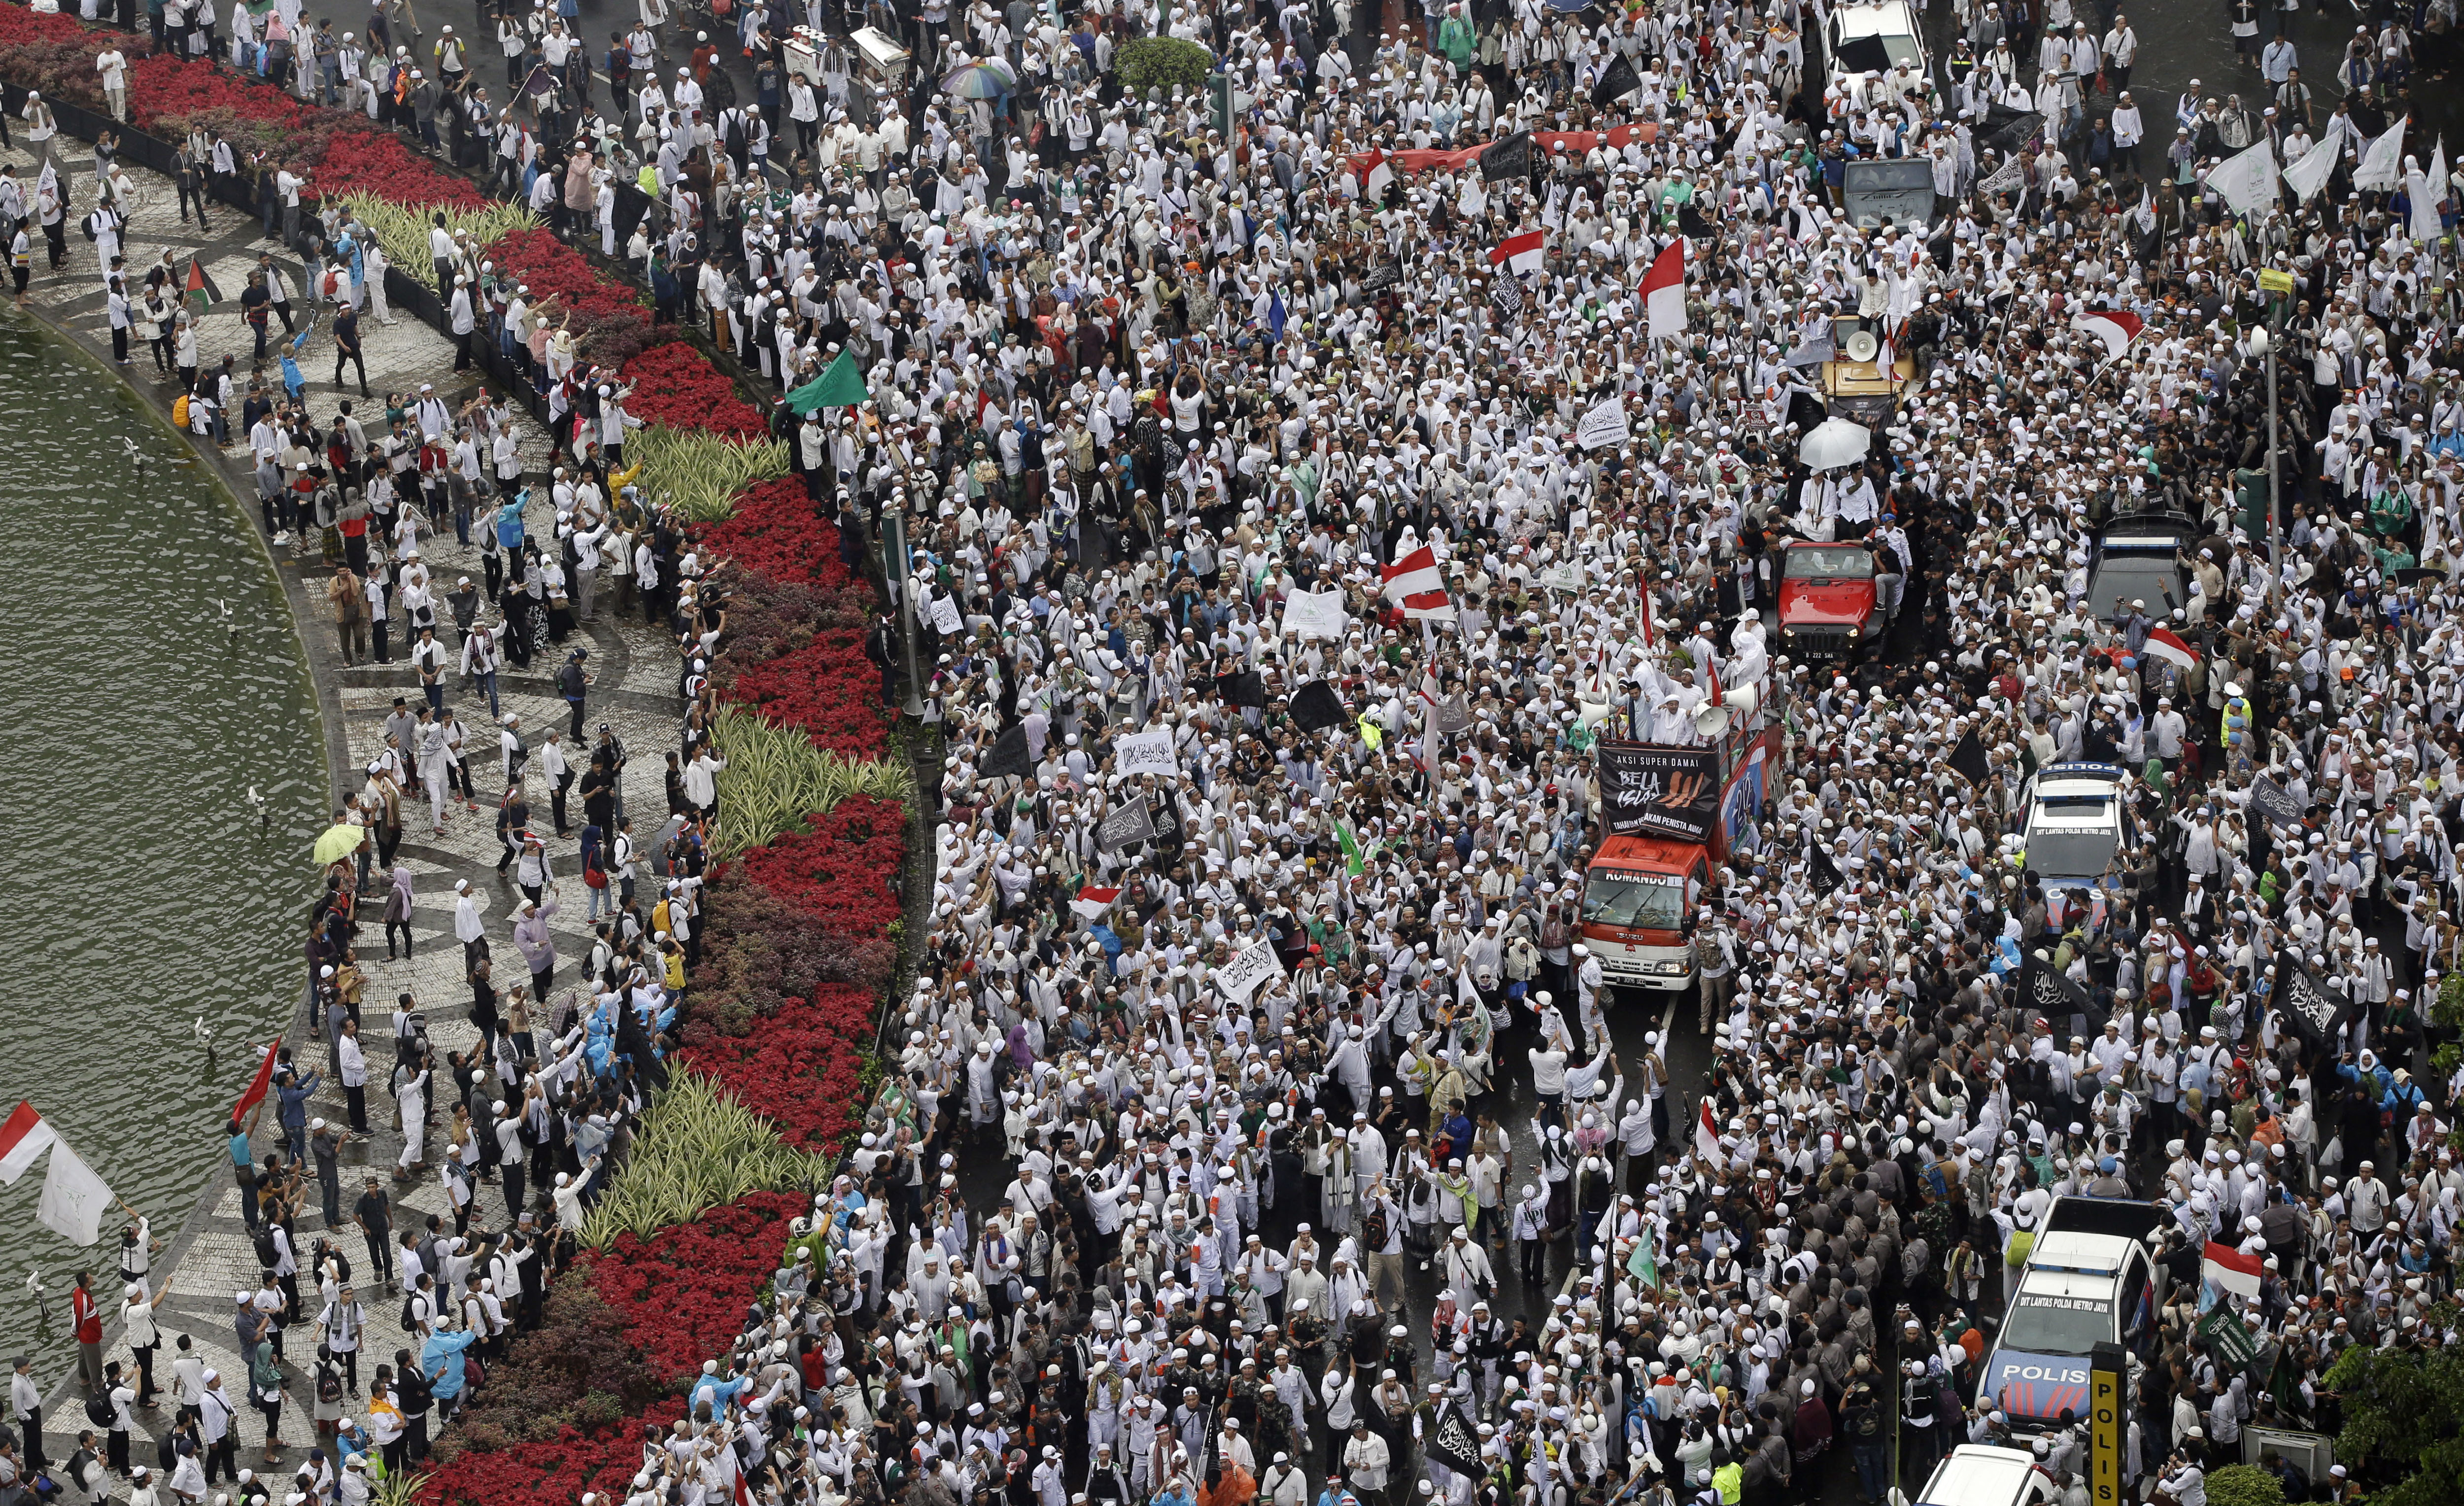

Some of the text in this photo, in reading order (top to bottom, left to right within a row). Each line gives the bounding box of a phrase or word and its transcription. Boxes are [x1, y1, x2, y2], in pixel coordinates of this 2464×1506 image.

[1617, 755, 1699, 767] AKSI SUPER DAMAI
[1618, 770, 1661, 796] BELA
[1662, 817, 1687, 830] PENISTA
[1606, 869, 1666, 886] KOMANDO
[1616, 932, 1643, 941] ISUZU
[2020, 1297, 2108, 1313] DIT LANTAS POLDA METRO JAYA
[2002, 1365, 2090, 1385] POLIS
[2097, 1383, 2113, 1500] POLIS
